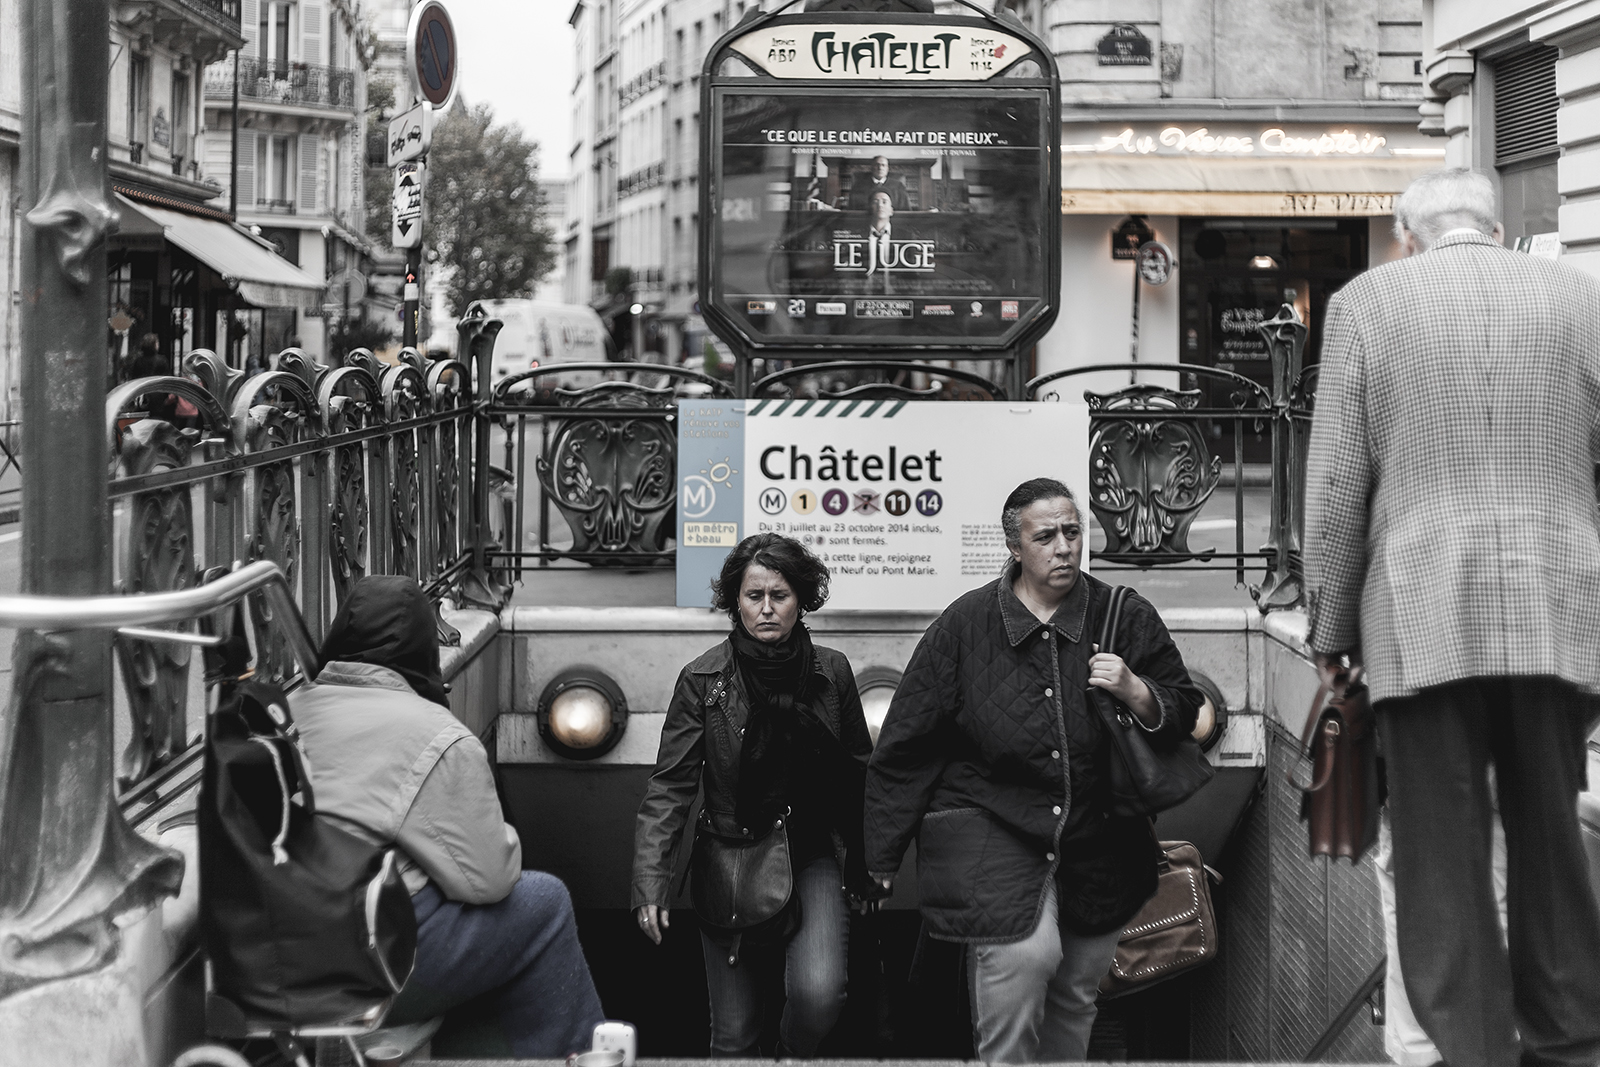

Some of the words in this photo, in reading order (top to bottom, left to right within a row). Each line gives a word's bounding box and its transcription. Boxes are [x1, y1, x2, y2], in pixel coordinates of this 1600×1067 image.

[812, 31, 961, 74] CHÂTELET
[788, 130, 816, 142] QUE
[820, 130, 837, 143] LE
[895, 131, 925, 144] FAIT
[927, 131, 946, 144] DE
[1159, 127, 1254, 152] Vieux
[1259, 128, 1387, 157] Comptoir
[834, 243, 863, 267] LE
[866, 236, 936, 276] JUGE
[788, 299, 806, 314] 20
[683, 429, 729, 438] stations
[760, 445, 942, 481] Châtelet
[799, 494, 808, 510] 1
[828, 493, 843, 511] 4
[887, 494, 907, 512] 11
[918, 494, 940, 512] 14
[687, 524, 700, 533] un
[703, 523, 735, 533] métro
[759, 522, 772, 531] Du
[776, 522, 786, 531] 31
[789, 522, 817, 533] juillet
[820, 524, 831, 532] au
[834, 522, 845, 532] 23
[848, 523, 885, 533] octobre
[887, 523, 909, 532] 2014
[912, 523, 942, 534] inclus,
[696, 533, 721, 543] beau
[829, 536, 850, 545] sont
[852, 536, 888, 545] fermés.
[832, 553, 856, 562] cette
[859, 552, 885, 564] ligne,
[887, 553, 931, 564] rejoignez
[840, 565, 865, 575] Neuf
[882, 565, 904, 575] Pont
[907, 566, 938, 575] Marie.
